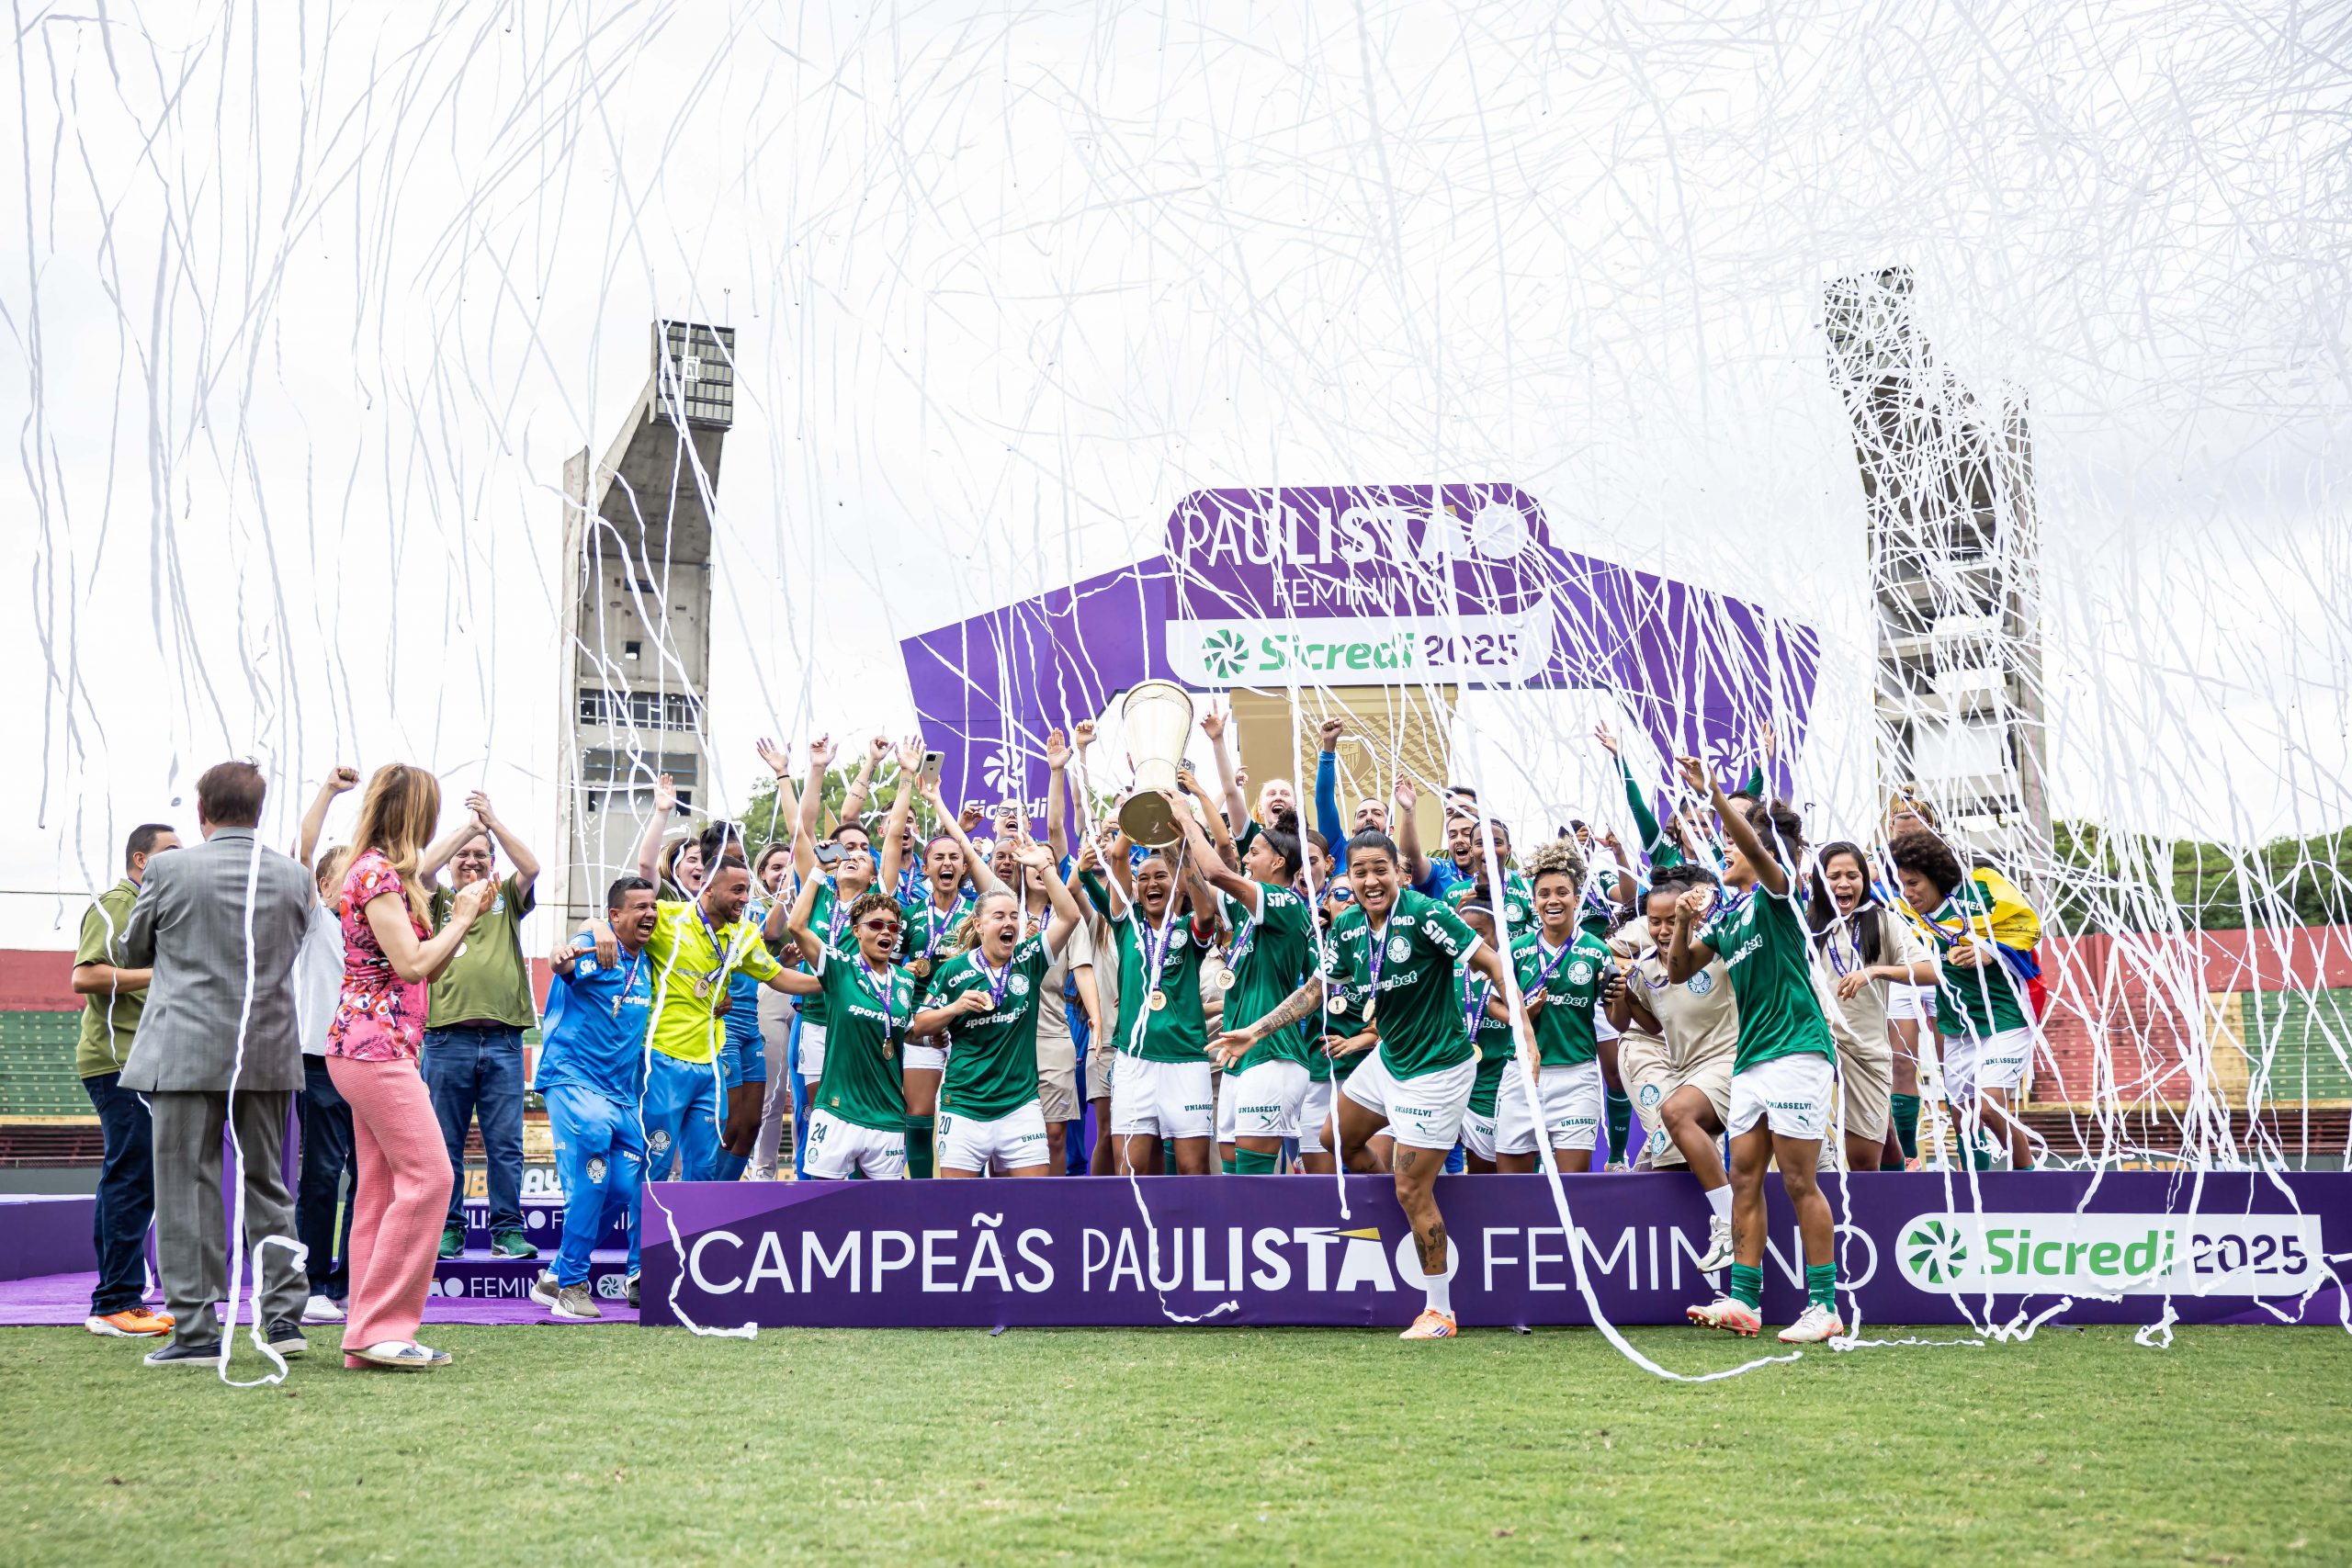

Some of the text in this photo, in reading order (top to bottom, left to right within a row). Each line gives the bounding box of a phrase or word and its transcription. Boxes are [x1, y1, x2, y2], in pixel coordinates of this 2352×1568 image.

[1272, 577, 1445, 607] FEMININO
[1259, 632, 1519, 671] Sicredi 2025
[965, 797, 1047, 821] Sicdi
[1341, 925, 1367, 942] CIMED
[1513, 945, 1538, 960] CIME
[1570, 945, 1603, 959] CIMED
[948, 970, 977, 987] CIMED
[1238, 1105, 1282, 1114] UNIASSELVI
[809, 1122, 828, 1144] 24
[938, 1115, 952, 1135] 20
[1476, 1124, 1494, 1136] UNIA
[689, 1213, 1055, 1294] CAMPEÃS
[1482, 1224, 1878, 1292] FEMINNO
[1980, 1229, 2176, 1276] Sicredi
[2191, 1234, 2309, 1276] 2025
